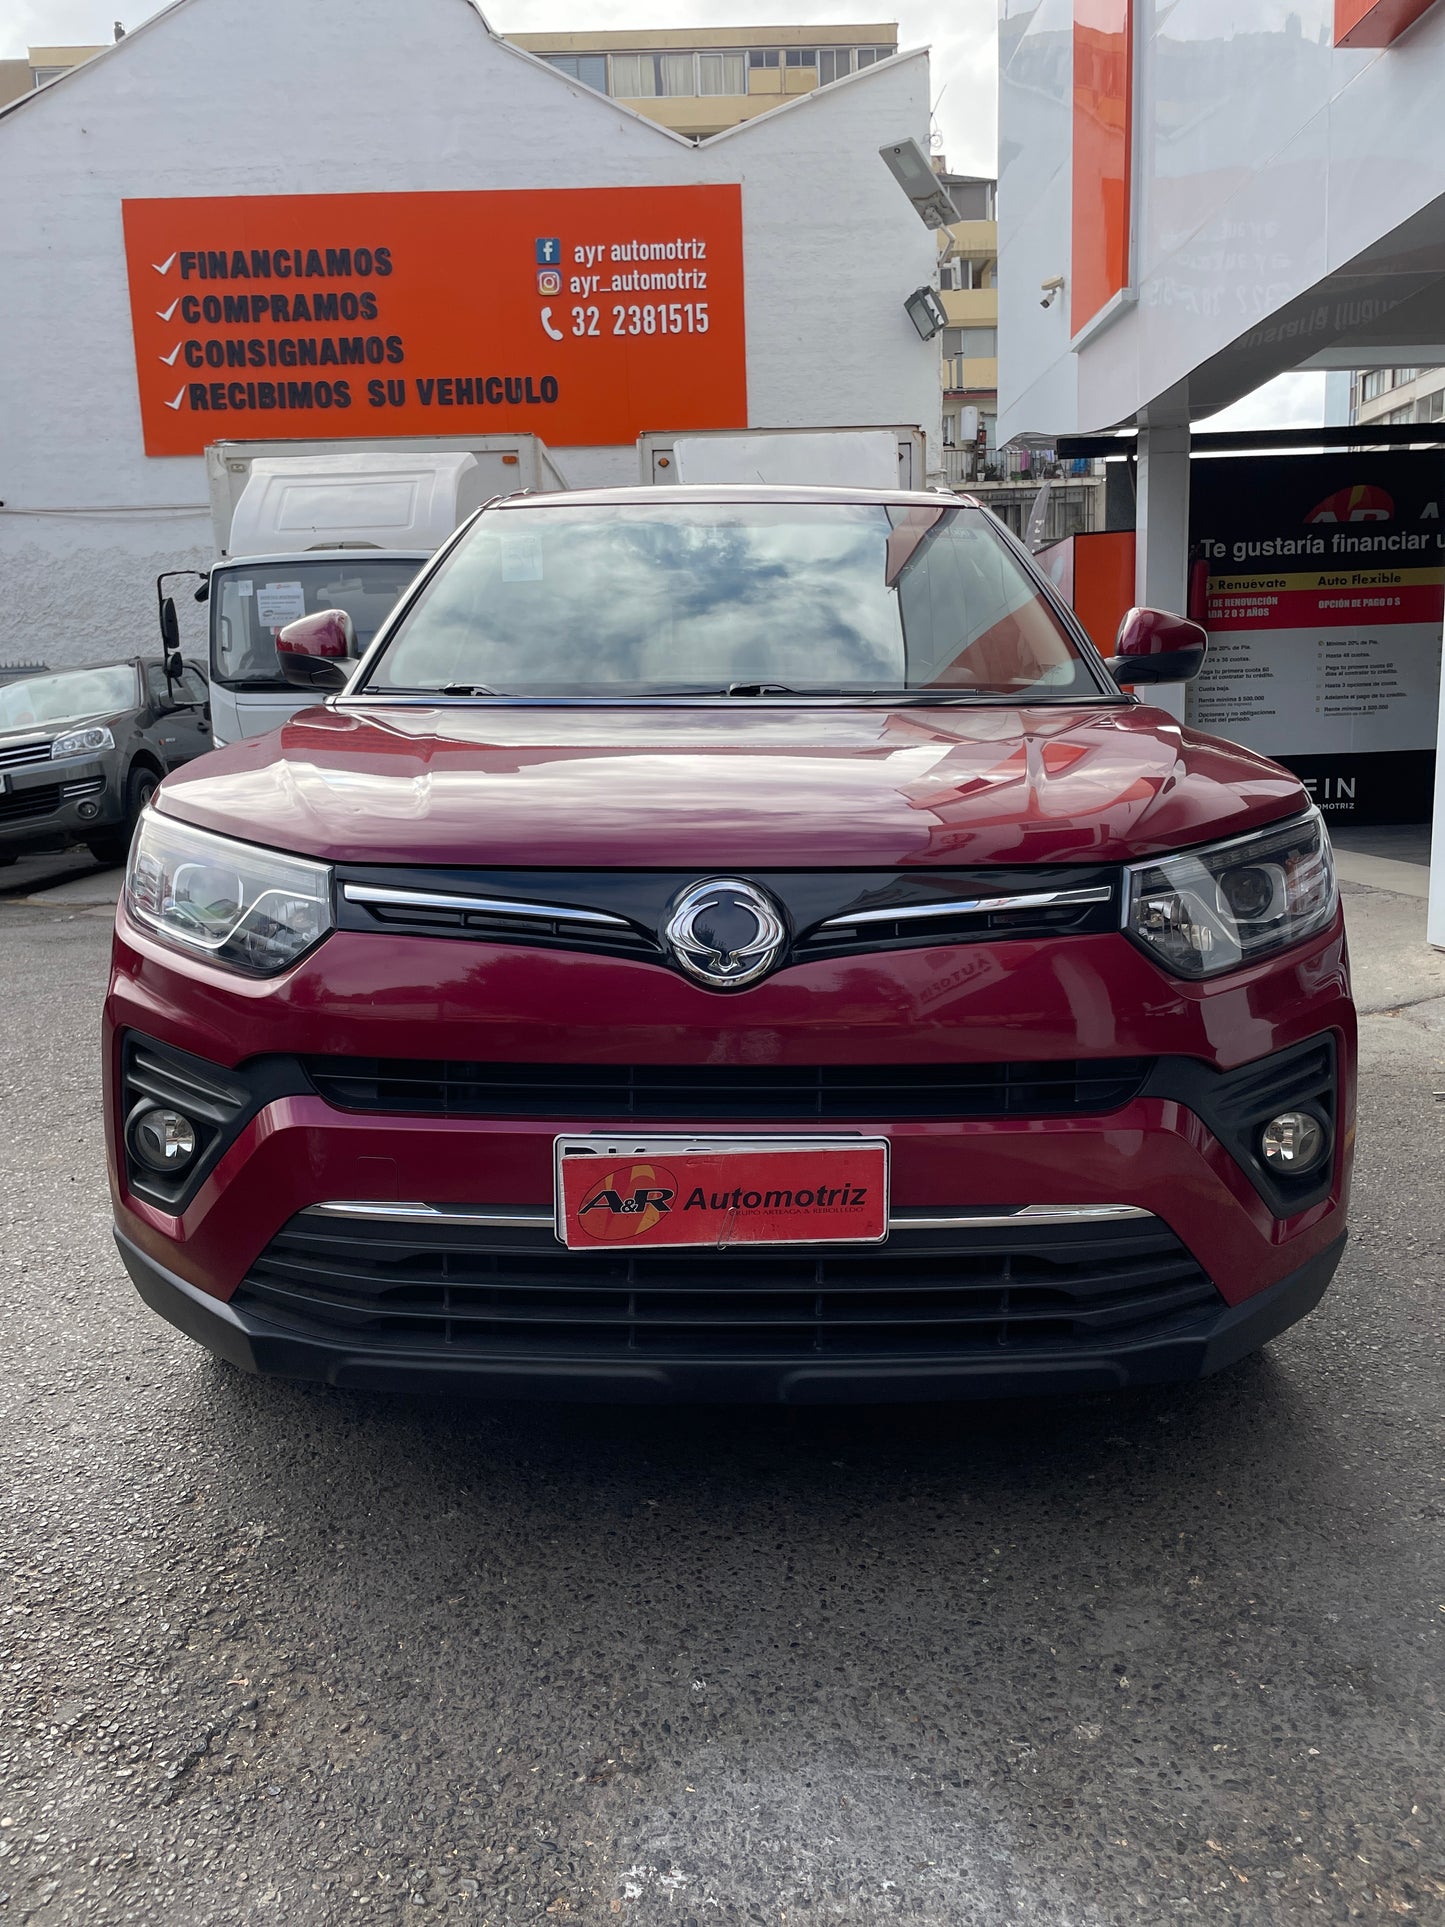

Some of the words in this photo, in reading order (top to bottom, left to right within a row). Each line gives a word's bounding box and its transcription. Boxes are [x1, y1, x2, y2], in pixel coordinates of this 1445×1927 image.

[180, 248, 393, 279] FINANCIAMOS
[574, 245, 605, 268] ayr
[611, 239, 706, 262] automotriz
[570, 269, 707, 298] ayr_automotriz
[182, 292, 378, 323] COMPRAMOS
[571, 306, 600, 336] 32
[612, 303, 709, 335] 2381515
[184, 336, 404, 367] CONSIGNAMOS
[189, 380, 351, 410] RECIBIMOS
[367, 380, 405, 406] SU
[416, 375, 559, 406] VEHICULO
[1233, 535, 1324, 562] gustaría
[1332, 531, 1429, 553] financiar
[1218, 579, 1286, 590] Renuévate
[1318, 576, 1347, 585] Auto
[1352, 573, 1401, 584] Flexible
[1224, 610, 1230, 618] 2
[1239, 609, 1245, 617] 3
[1246, 607, 1269, 617] AÑOS
[1351, 599, 1361, 607] DE
[1363, 598, 1385, 607] PAGO
[577, 1188, 676, 1215] A&R
[683, 1183, 868, 1211] Automotriz
